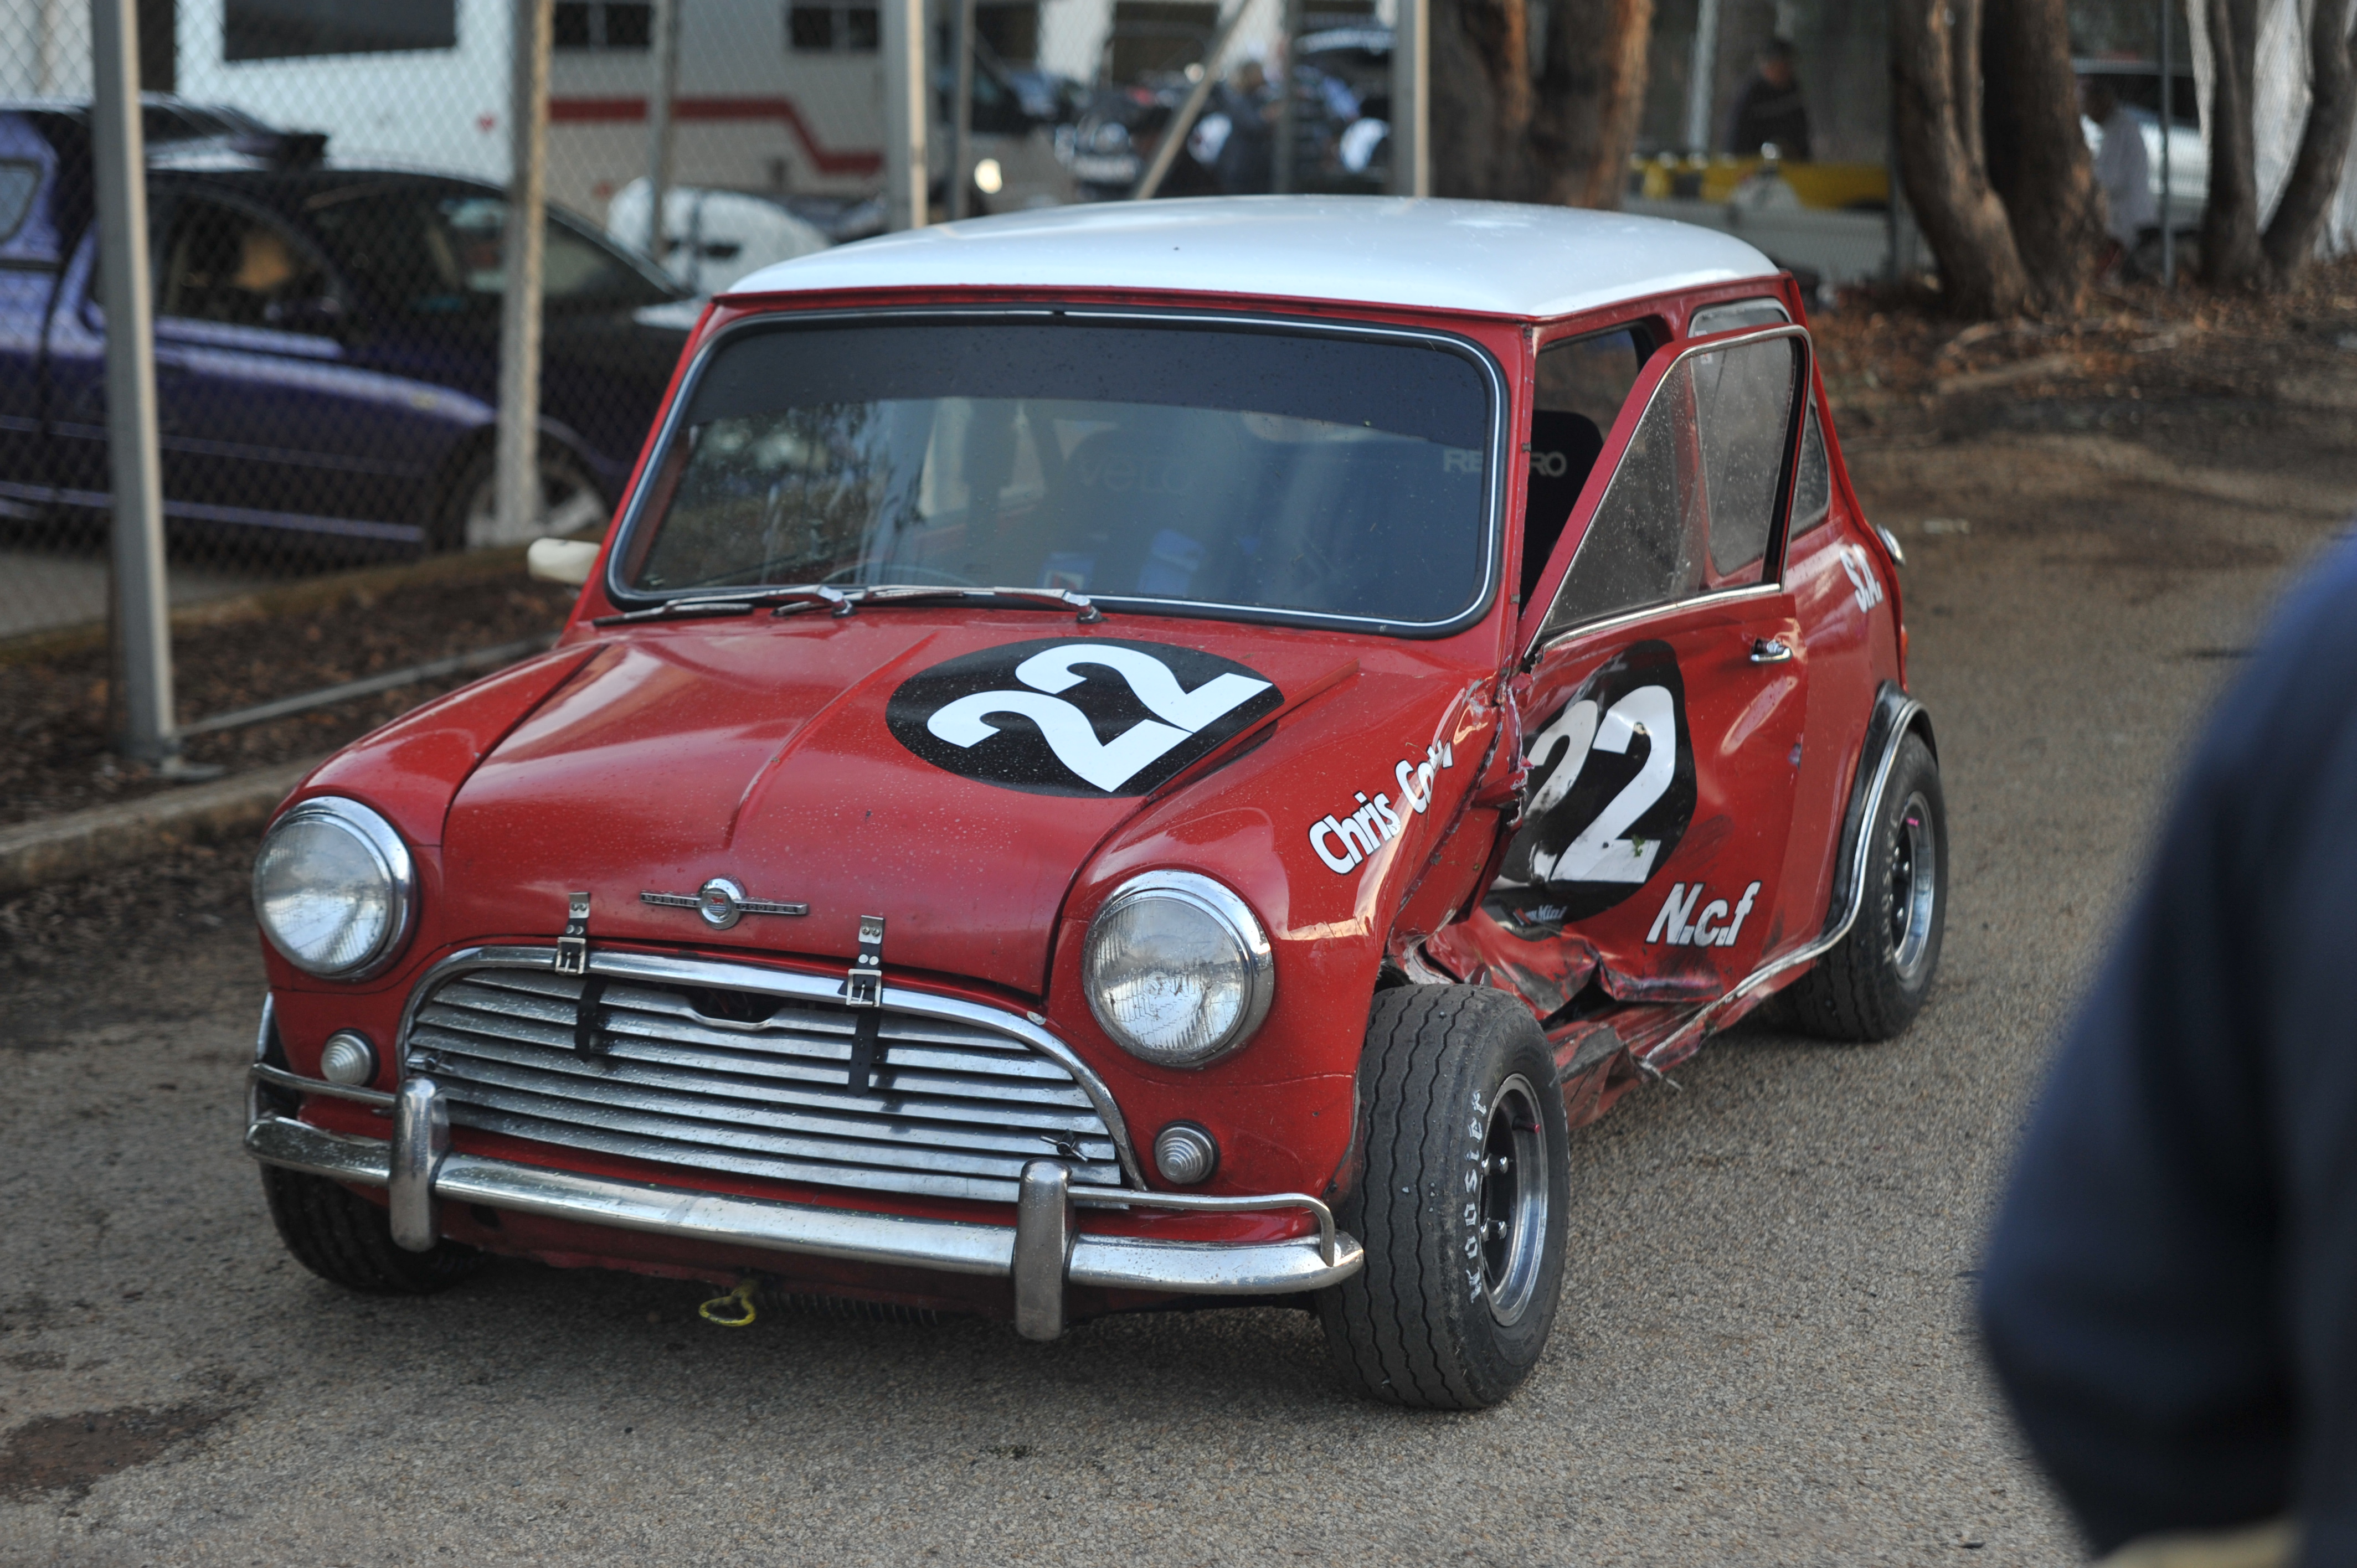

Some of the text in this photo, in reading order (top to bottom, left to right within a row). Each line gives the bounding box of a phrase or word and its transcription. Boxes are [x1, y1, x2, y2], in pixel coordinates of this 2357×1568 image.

[1443, 447, 1567, 477] RERO
[927, 643, 1274, 793] 22
[1525, 684, 1676, 884] 22
[1309, 791, 1401, 875] Chris
[643, 894, 796, 913] MORRIS COOPER
